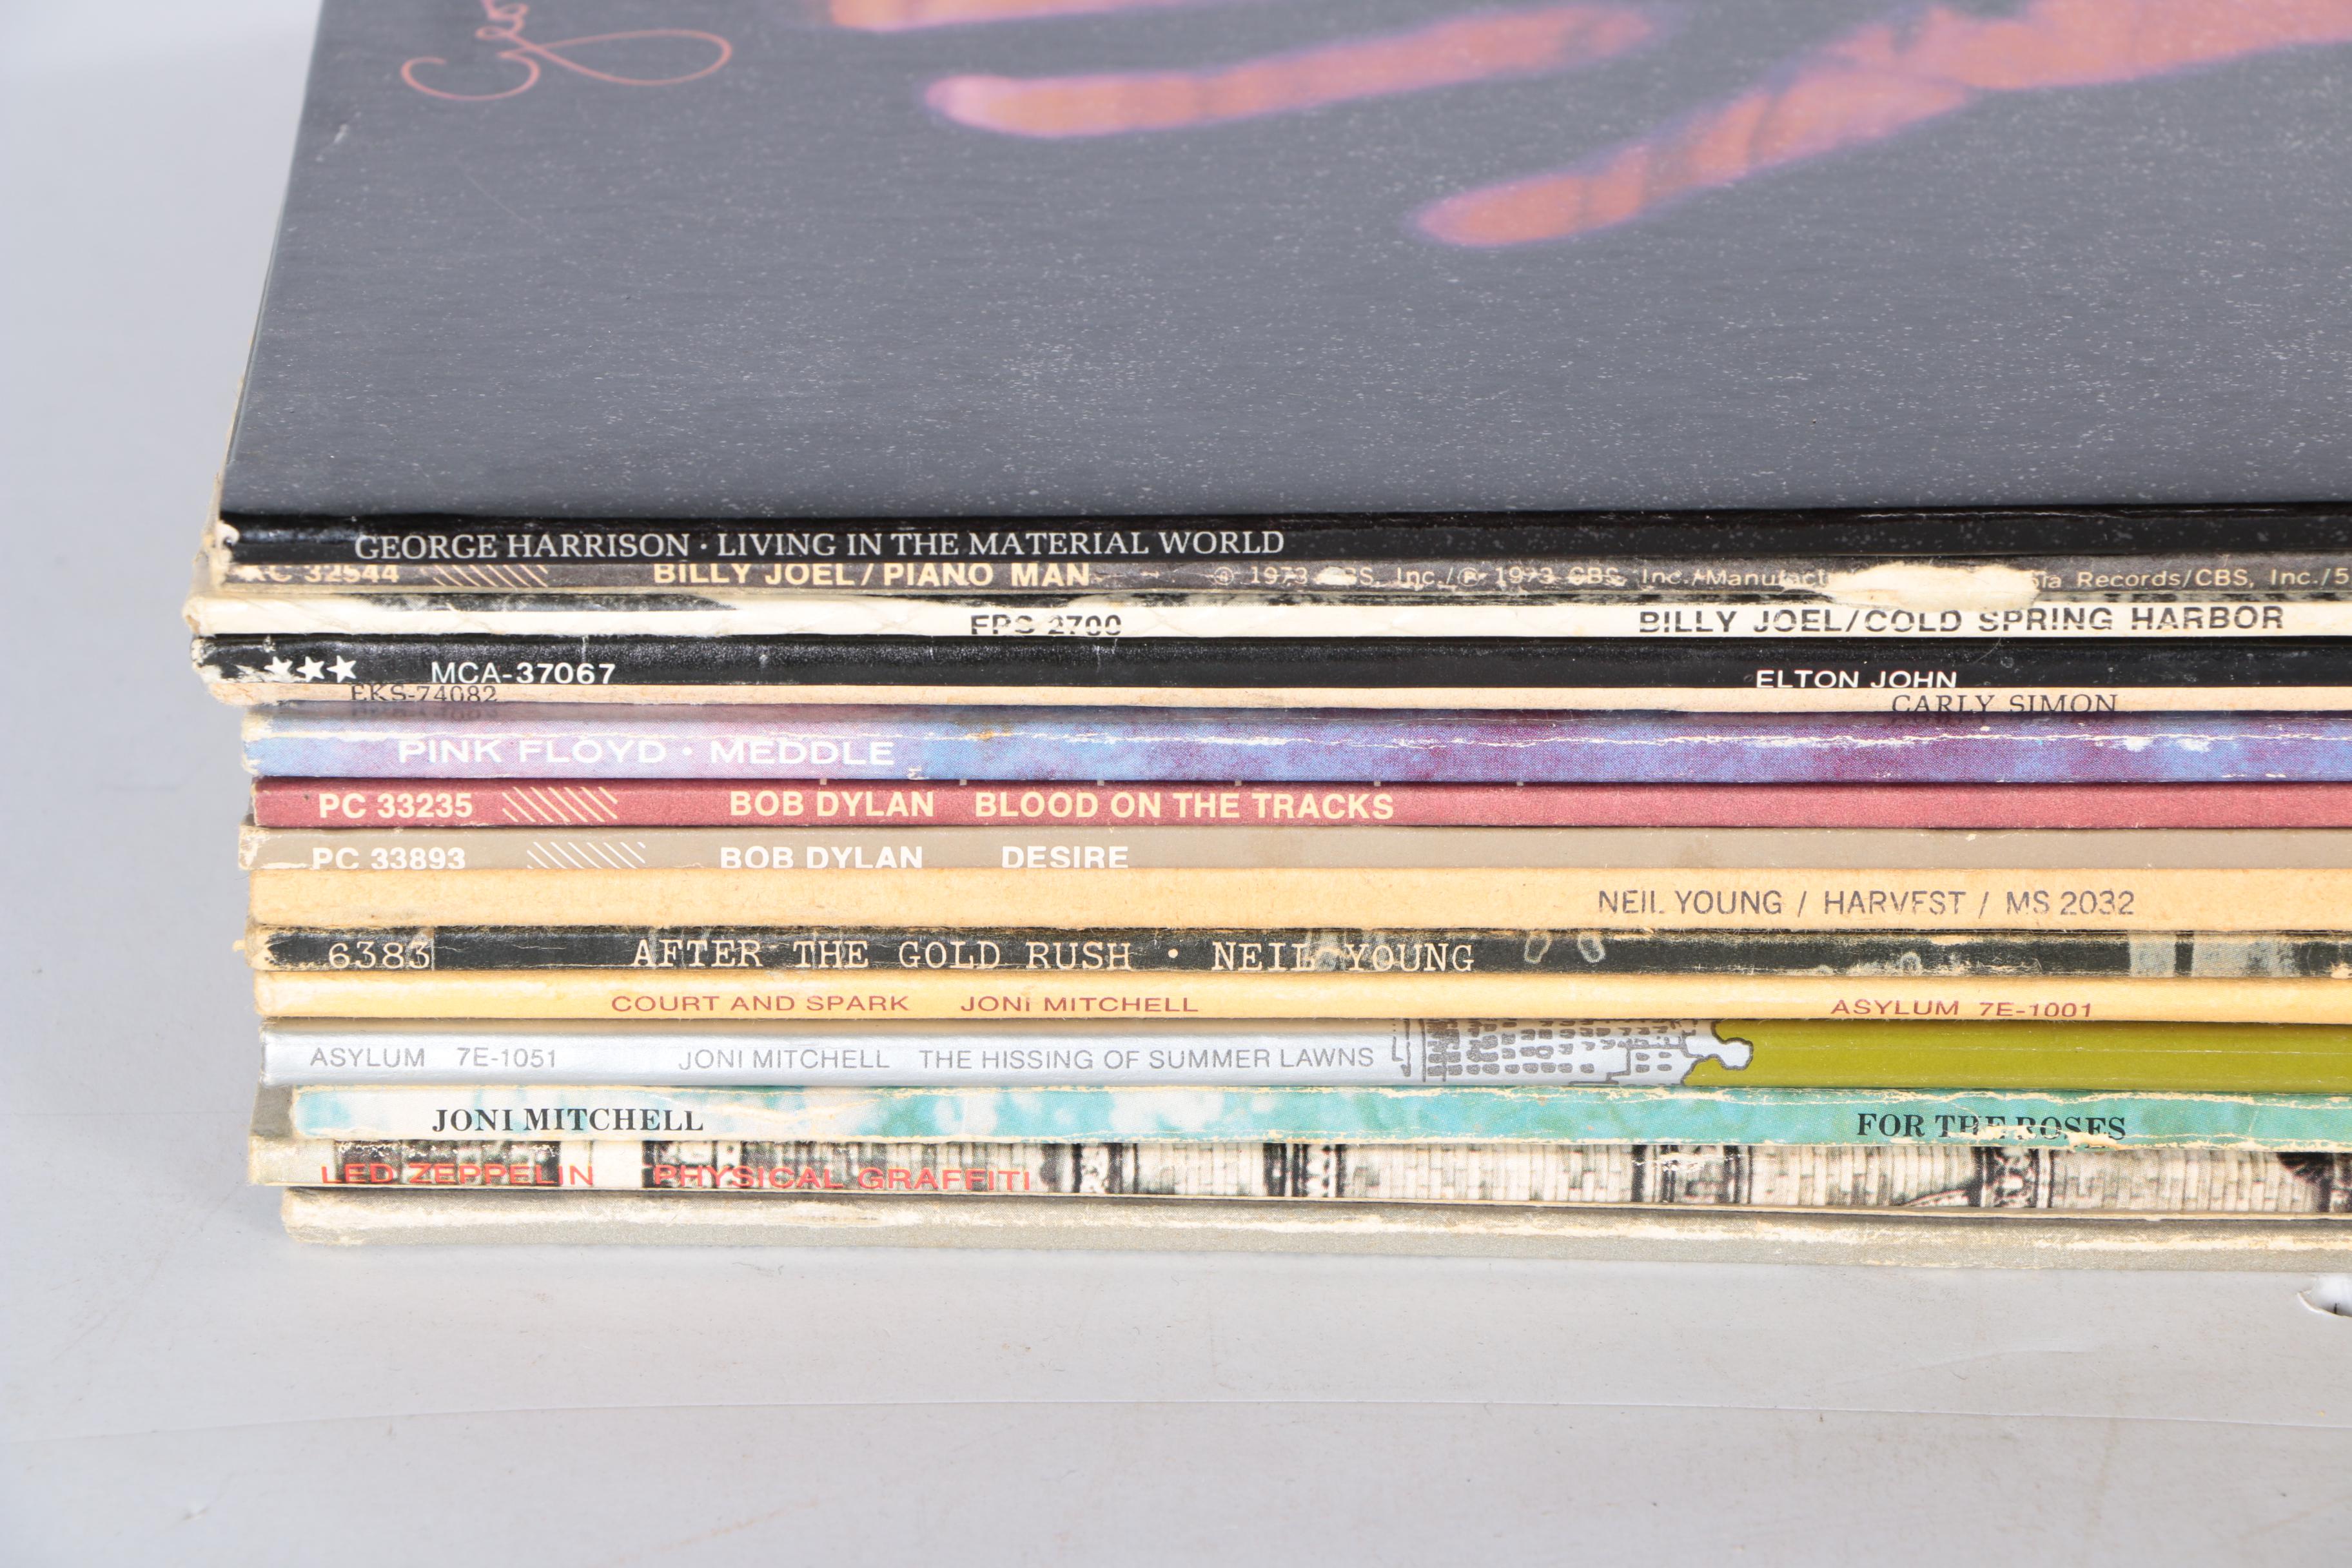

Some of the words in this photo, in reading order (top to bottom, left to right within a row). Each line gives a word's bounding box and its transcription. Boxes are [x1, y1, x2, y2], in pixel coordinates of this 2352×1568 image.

[355, 536, 496, 560] GEORGE
[508, 534, 689, 558] HARRISON
[718, 533, 836, 556] LIVING
[848, 533, 881, 556] IN
[891, 533, 959, 556] THE
[968, 532, 1149, 556] MATERIAL
[1159, 531, 1284, 554] WORLD
[304, 564, 400, 583] 32544
[654, 564, 751, 583] BILLY
[1012, 563, 1090, 586] MAN
[2077, 568, 2254, 588] Records/CBS,
[1048, 614, 1122, 636] 2700
[1640, 611, 1737, 633] BILLY
[1978, 607, 2112, 632] SPRING
[2132, 605, 2283, 630] HARBOR
[431, 662, 615, 684] MCA-37067
[1756, 670, 1859, 688] ELTON
[1870, 671, 1957, 688] JOHN
[351, 683, 498, 702] EKS-74082
[1892, 694, 1995, 712] CARLY
[2010, 694, 2118, 712] SIMON
[398, 740, 503, 763] PINK
[520, 740, 667, 763] FLOYD
[710, 740, 895, 765] MEDDLE
[318, 793, 366, 818] PC
[378, 793, 473, 818] 33235
[730, 791, 804, 817] BOB
[817, 791, 934, 817] DYLAN
[975, 792, 1098, 818] BLOOD
[1111, 792, 1161, 818] ON
[1173, 793, 1240, 818] THE
[1252, 793, 1393, 819] TRACKS
[313, 847, 358, 869] PC
[371, 847, 466, 870] 33893
[720, 846, 794, 868] BOB
[807, 846, 922, 868] DYLAN
[1002, 846, 1128, 868] DESIRE
[1599, 890, 1663, 915] NEIL
[1675, 890, 1782, 915] YOUNG
[1825, 891, 1966, 916] HARVEST
[2006, 891, 2052, 915] MS
[2060, 890, 2135, 916] 2032
[328, 941, 431, 969] 6383
[632, 939, 763, 968] AFTER
[794, 940, 868, 968] THE
[899, 941, 1001, 969] GOLD
[1025, 941, 1133, 970] RUSH
[1211, 941, 1317, 971] NEIL
[1348, 943, 1475, 972] YOUNG
[611, 995, 720, 1012] COURT
[730, 995, 795, 1012] AND
[807, 995, 910, 1012] SPARK
[961, 995, 1032, 1012] JONI
[1044, 997, 1198, 1013] MITCHELL
[1830, 999, 1959, 1016] ASYLUM
[1981, 1001, 2092, 1017] 7E-1001
[310, 1047, 425, 1068] ASYLUM
[457, 1047, 556, 1068] 7E-1051
[678, 1049, 743, 1070] JONI
[754, 1049, 890, 1069] MITCHELL
[919, 1049, 971, 1070] THE
[982, 1049, 1093, 1070] HISSING
[1104, 1049, 1139, 1070] OF
[1149, 1048, 1270, 1069] SUMMER
[1280, 1047, 1374, 1068] LAWNS
[432, 1108, 513, 1132] JONI
[524, 1108, 704, 1132] MITCHELL
[1857, 1113, 1925, 1137] FOR
[1935, 1115, 2005, 1139] THE
[2016, 1116, 2126, 1140] ROSES
[322, 1163, 393, 1184] LED
[409, 1163, 593, 1186] ZEPPELIN
[654, 1164, 844, 1189] PHYSICAL
[858, 1168, 1030, 1191] GRAFFITI
